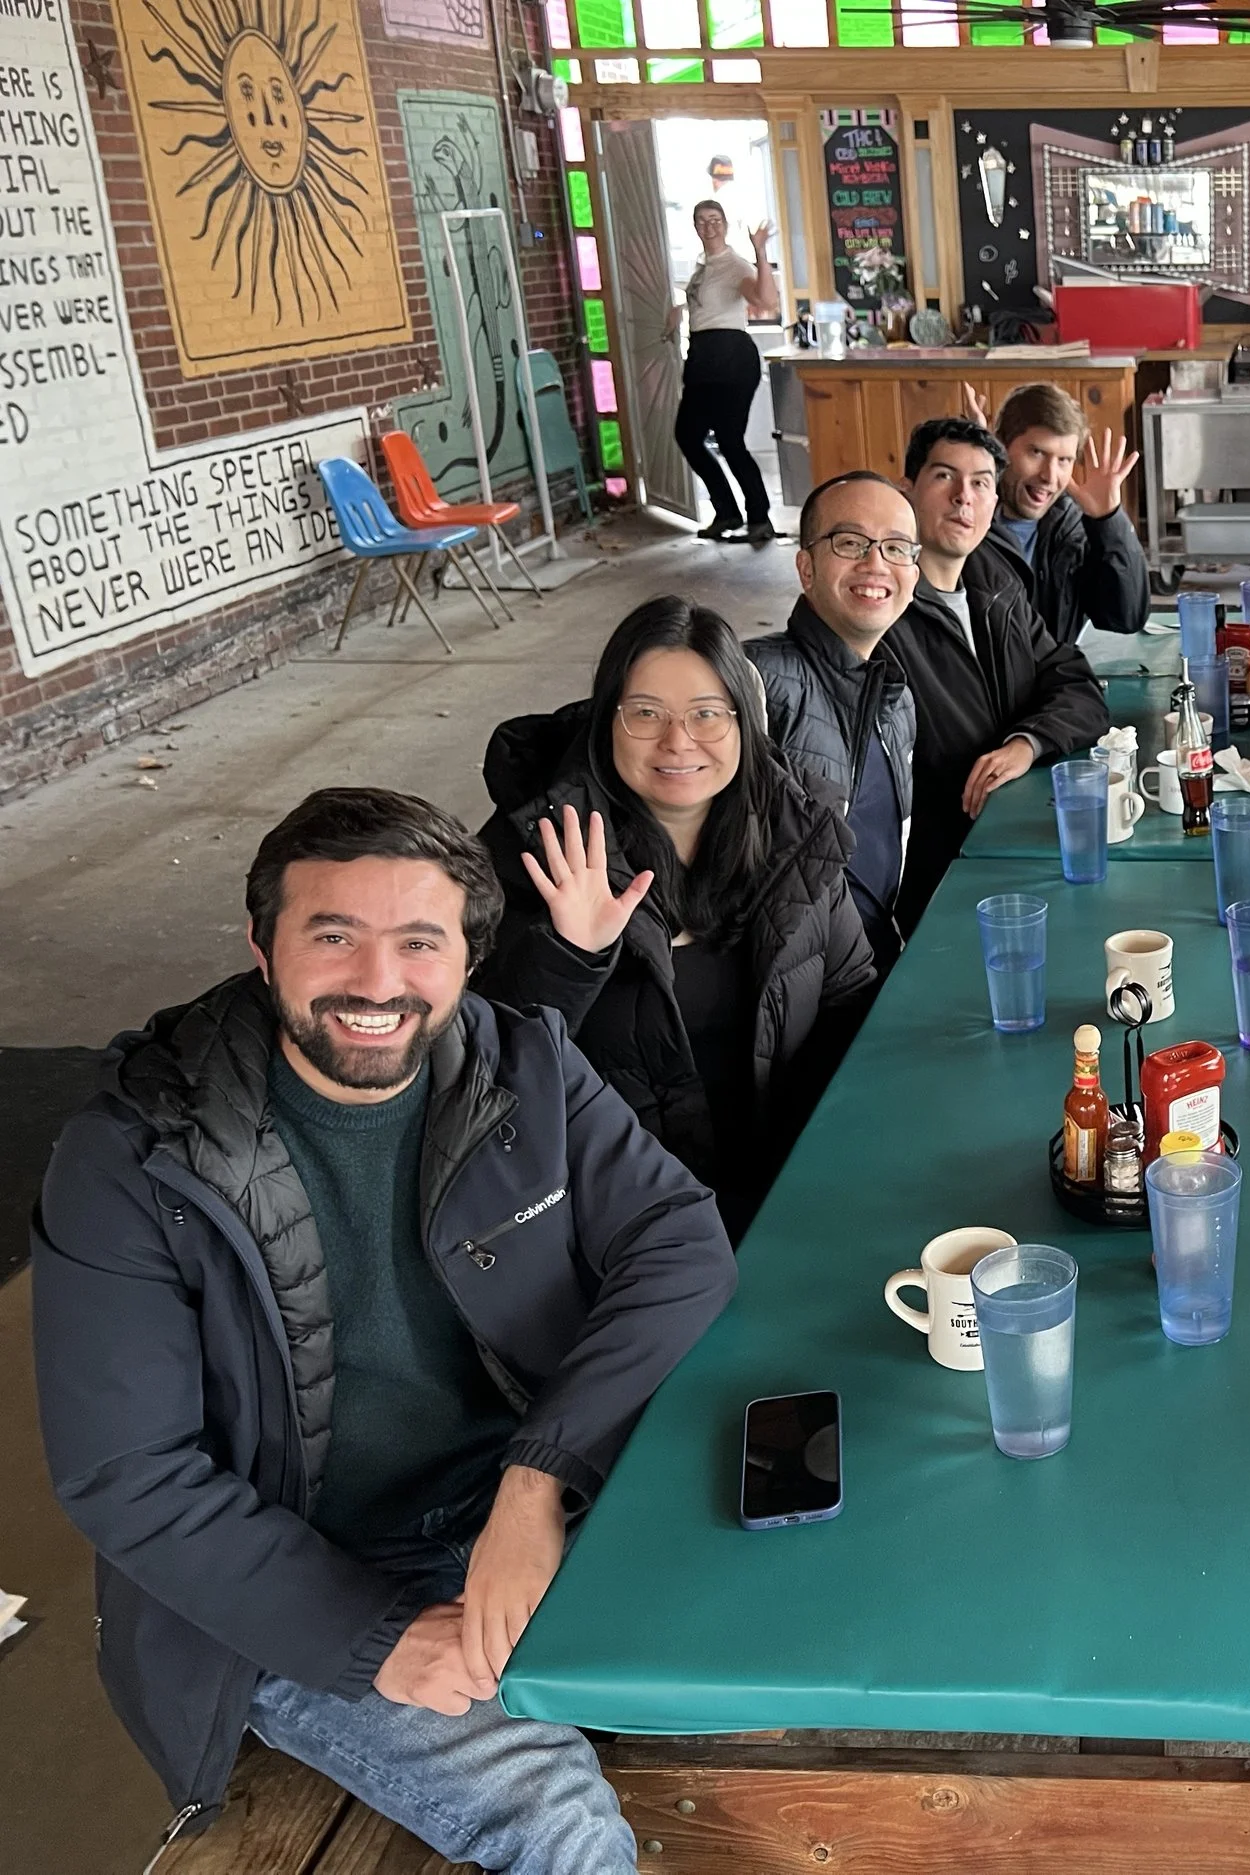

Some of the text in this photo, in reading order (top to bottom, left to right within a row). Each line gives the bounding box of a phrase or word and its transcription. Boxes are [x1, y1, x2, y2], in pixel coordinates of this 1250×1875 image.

[42, 71, 63, 100] IS
[51, 206, 93, 236] THE
[66, 252, 105, 279] THAT
[54, 295, 113, 325] WERE
[15, 440, 318, 554] SOMETHING SPECIAL
[27, 534, 122, 592] ABOUT
[138, 512, 192, 553] THE
[206, 482, 312, 533] THINGS
[38, 570, 150, 641] NEVER
[160, 538, 236, 594] WERE
[246, 522, 285, 565] AN
[1186, 1096, 1208, 1109] HEINZ
[515, 1189, 566, 1223] Calvin Klein
